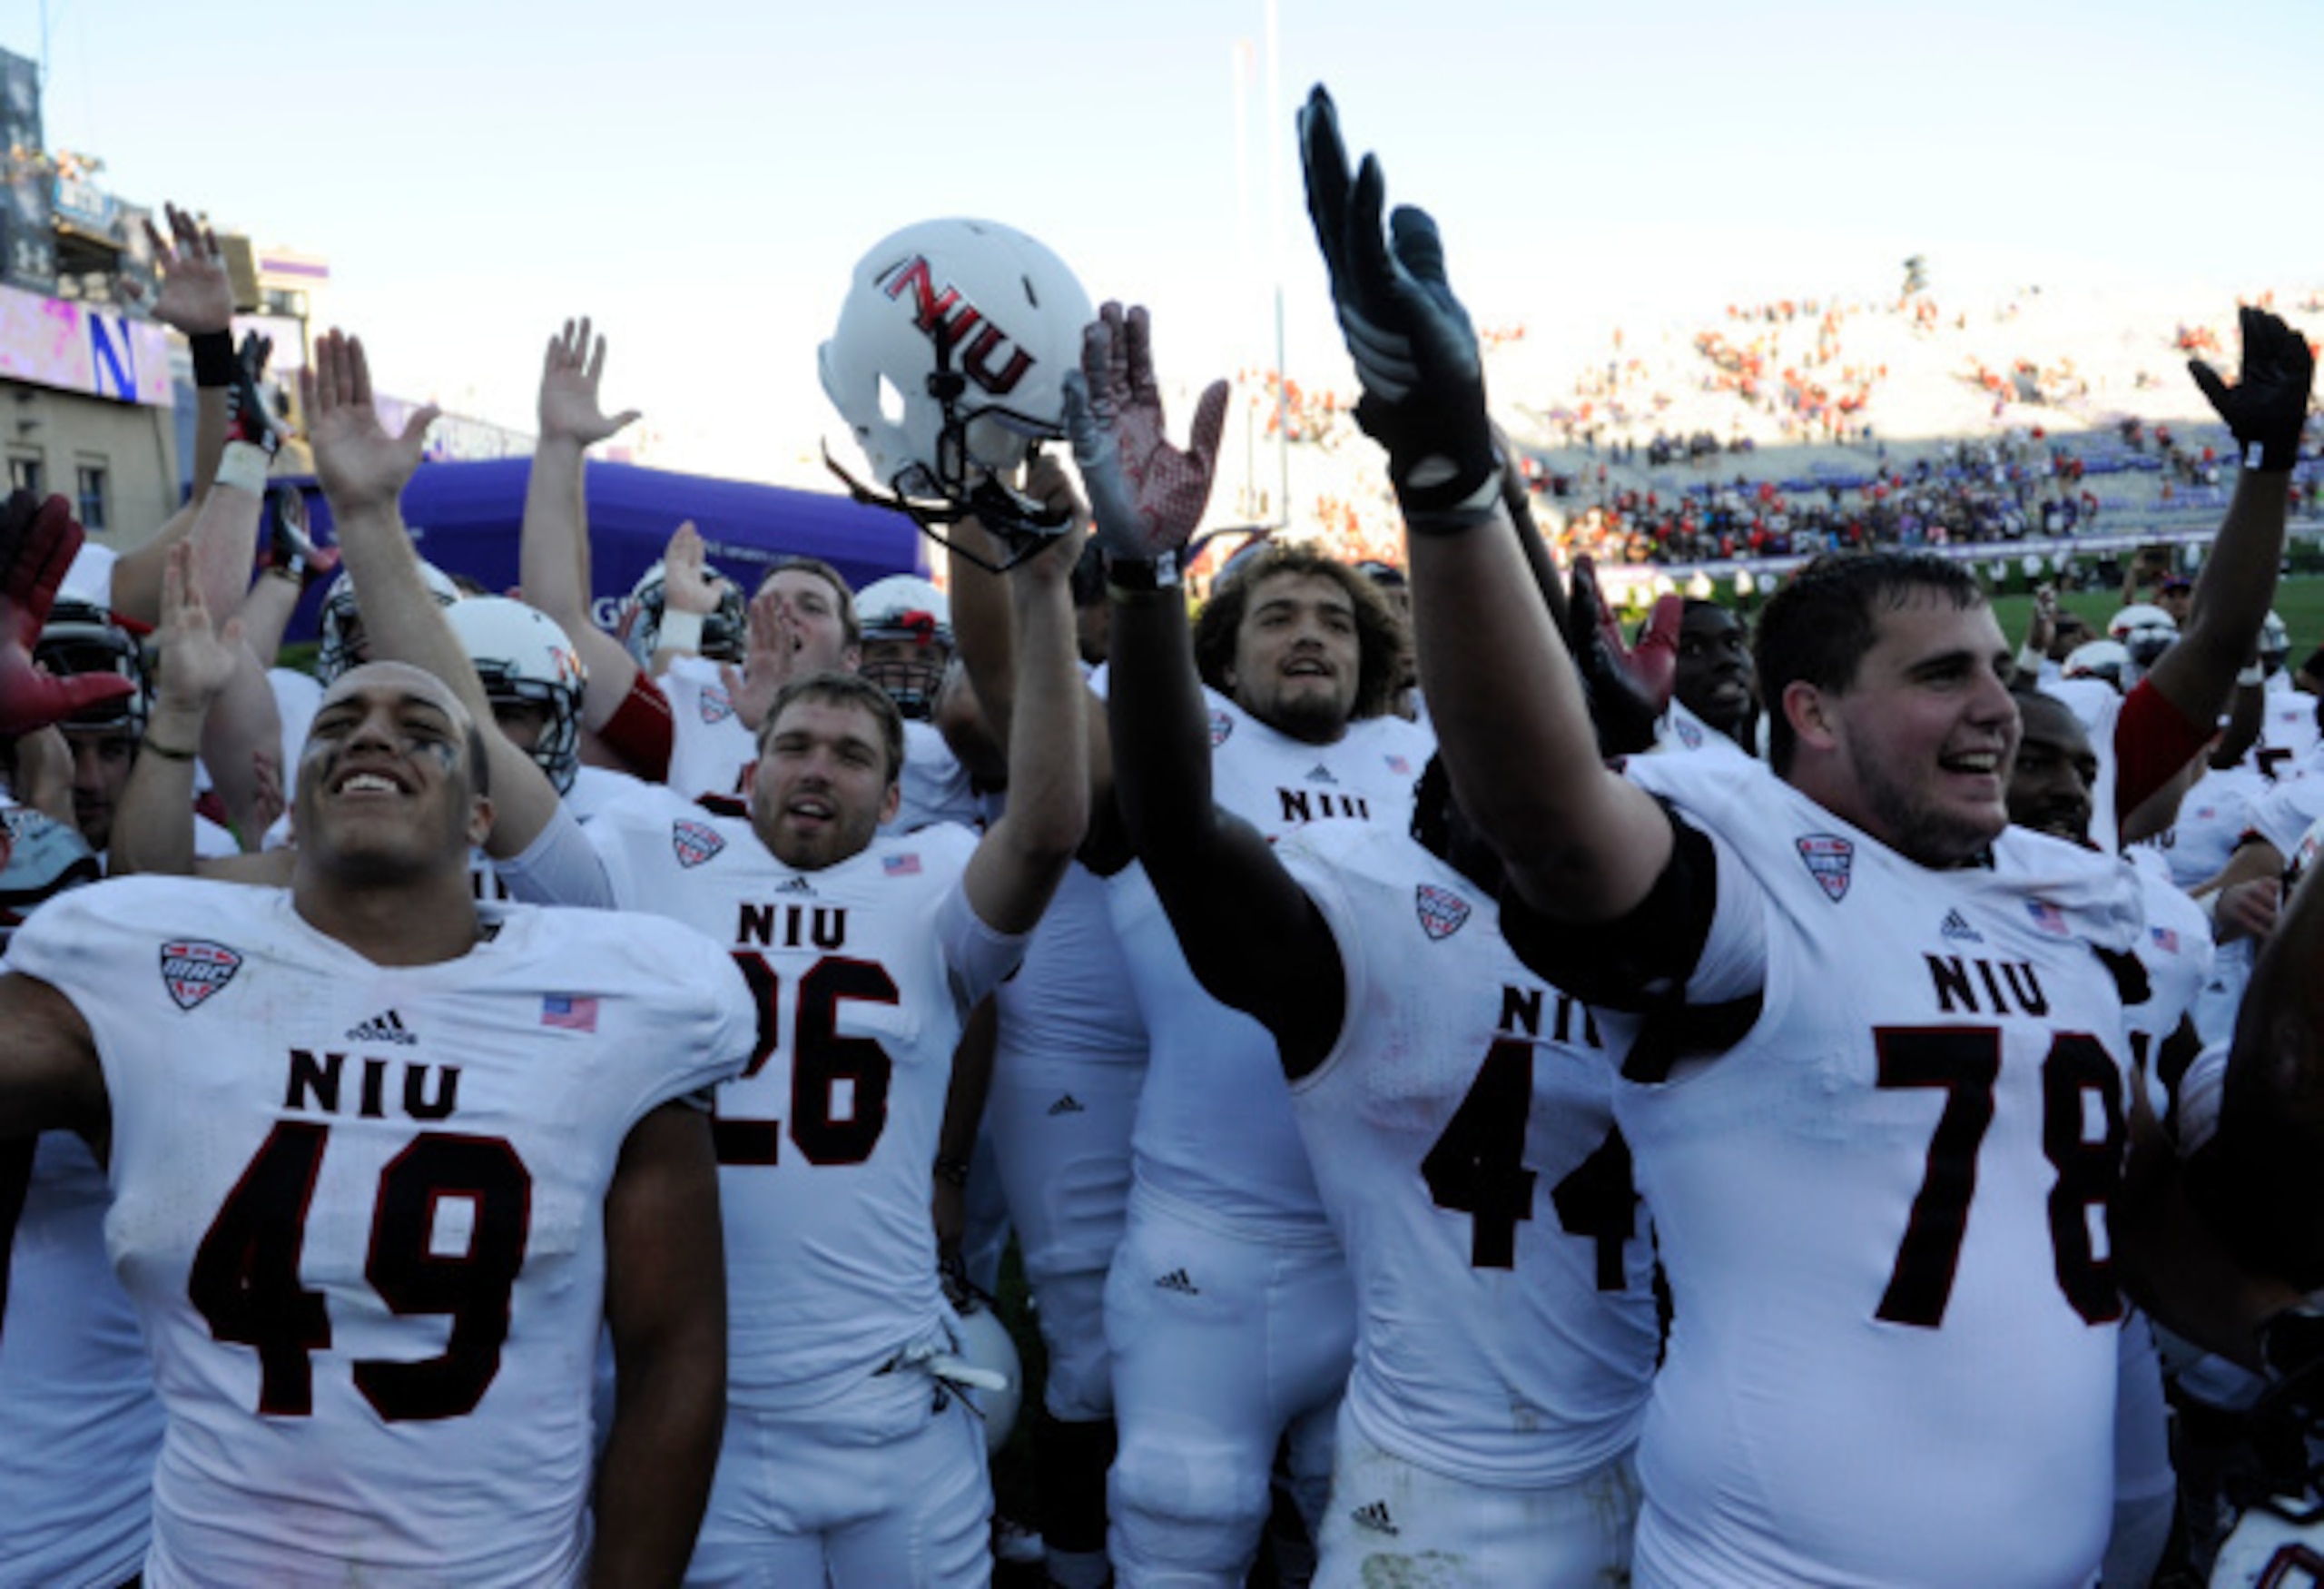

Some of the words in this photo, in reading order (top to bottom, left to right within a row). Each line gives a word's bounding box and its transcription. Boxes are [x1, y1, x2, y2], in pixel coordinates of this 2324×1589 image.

[87, 312, 138, 403] N
[882, 254, 1039, 396] NIU
[736, 902, 848, 951] NIU
[1923, 952, 2050, 1017] NIU
[283, 1049, 461, 1122] NIU
[713, 951, 901, 1165] 26
[1420, 1038, 1643, 1292] 44
[1871, 1026, 2124, 1329] 78
[188, 1120, 533, 1424] 49
